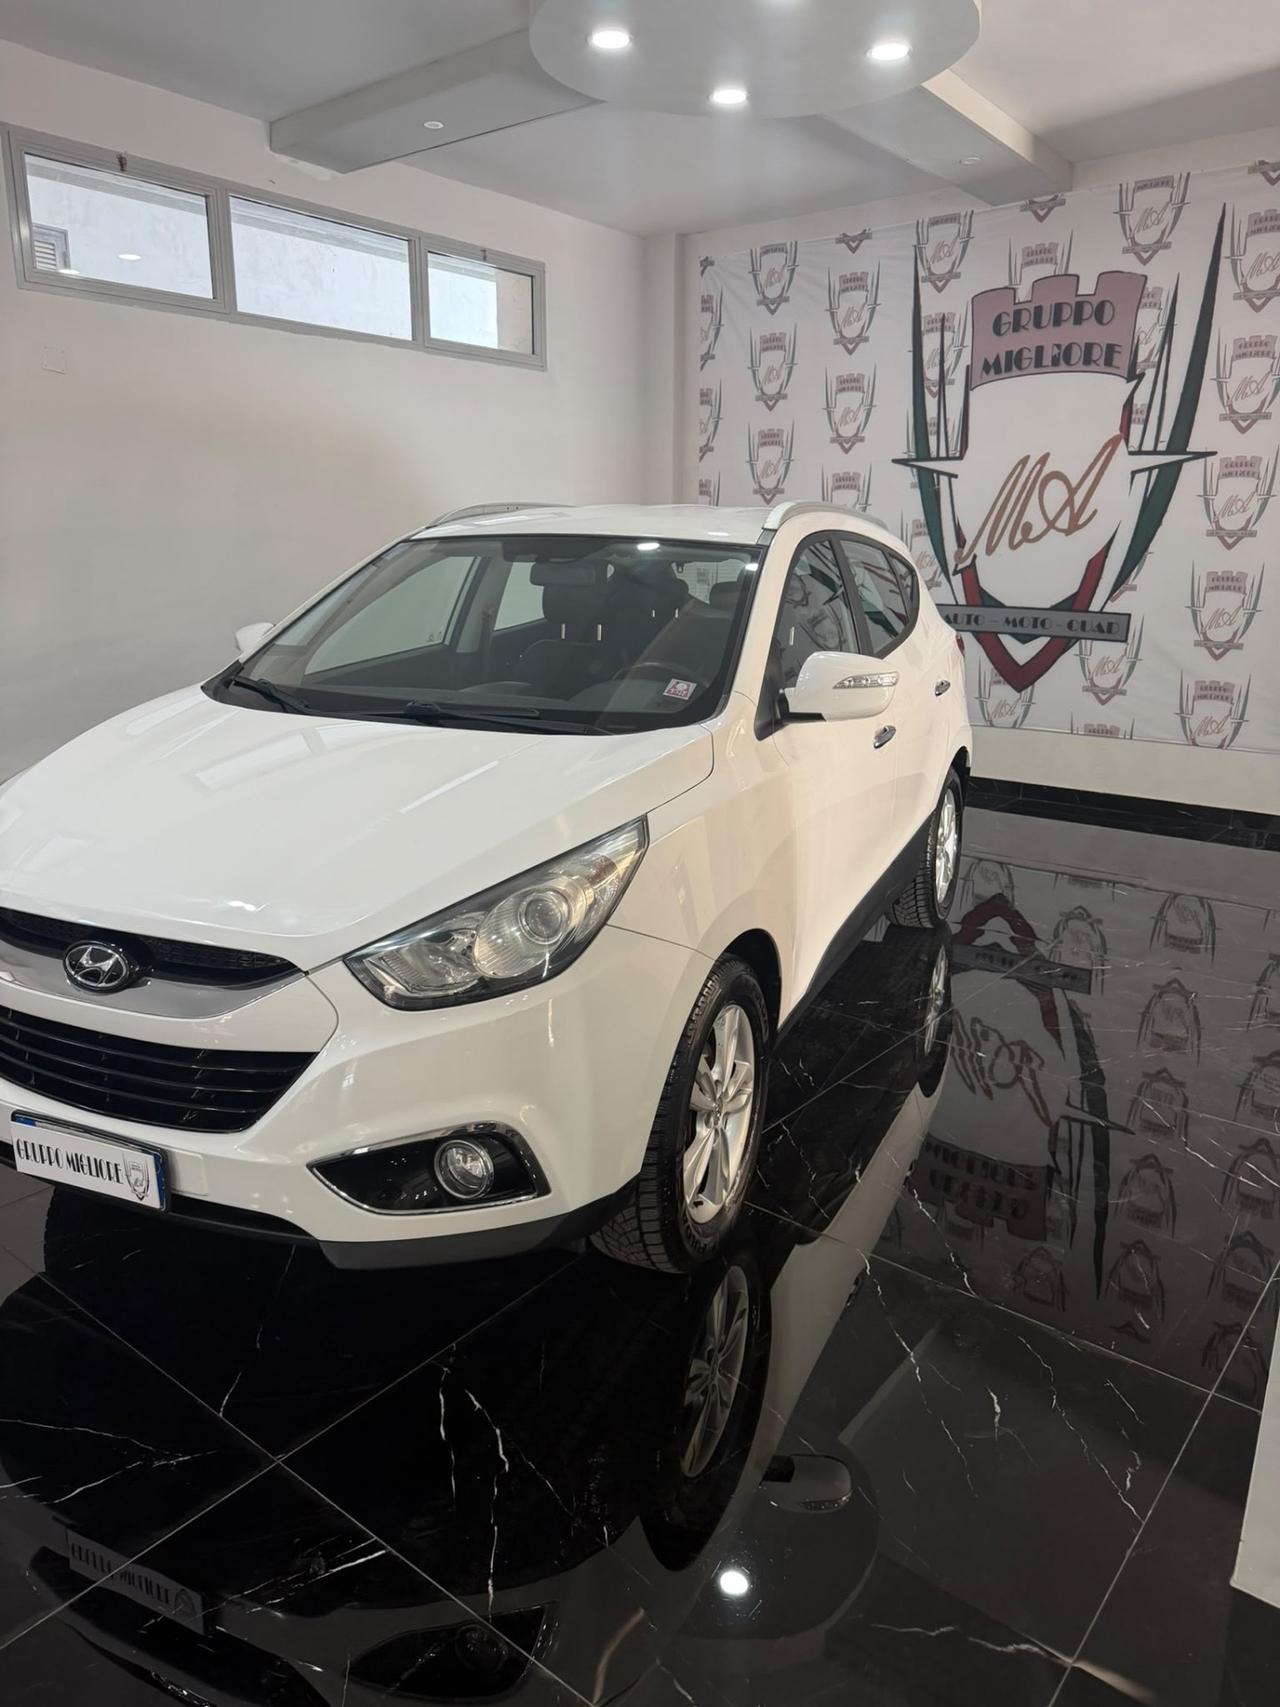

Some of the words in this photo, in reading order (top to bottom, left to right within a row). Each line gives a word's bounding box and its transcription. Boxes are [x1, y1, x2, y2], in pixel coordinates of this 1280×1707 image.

[992, 300, 1115, 337] GRUPPO
[980, 342, 1122, 381] MIGLIORE
[943, 613, 985, 626] AUTO
[1003, 616, 1052, 631] MOTO
[16, 1138, 63, 1169] GRUPPO
[66, 1151, 123, 1184] MIGLIORE
